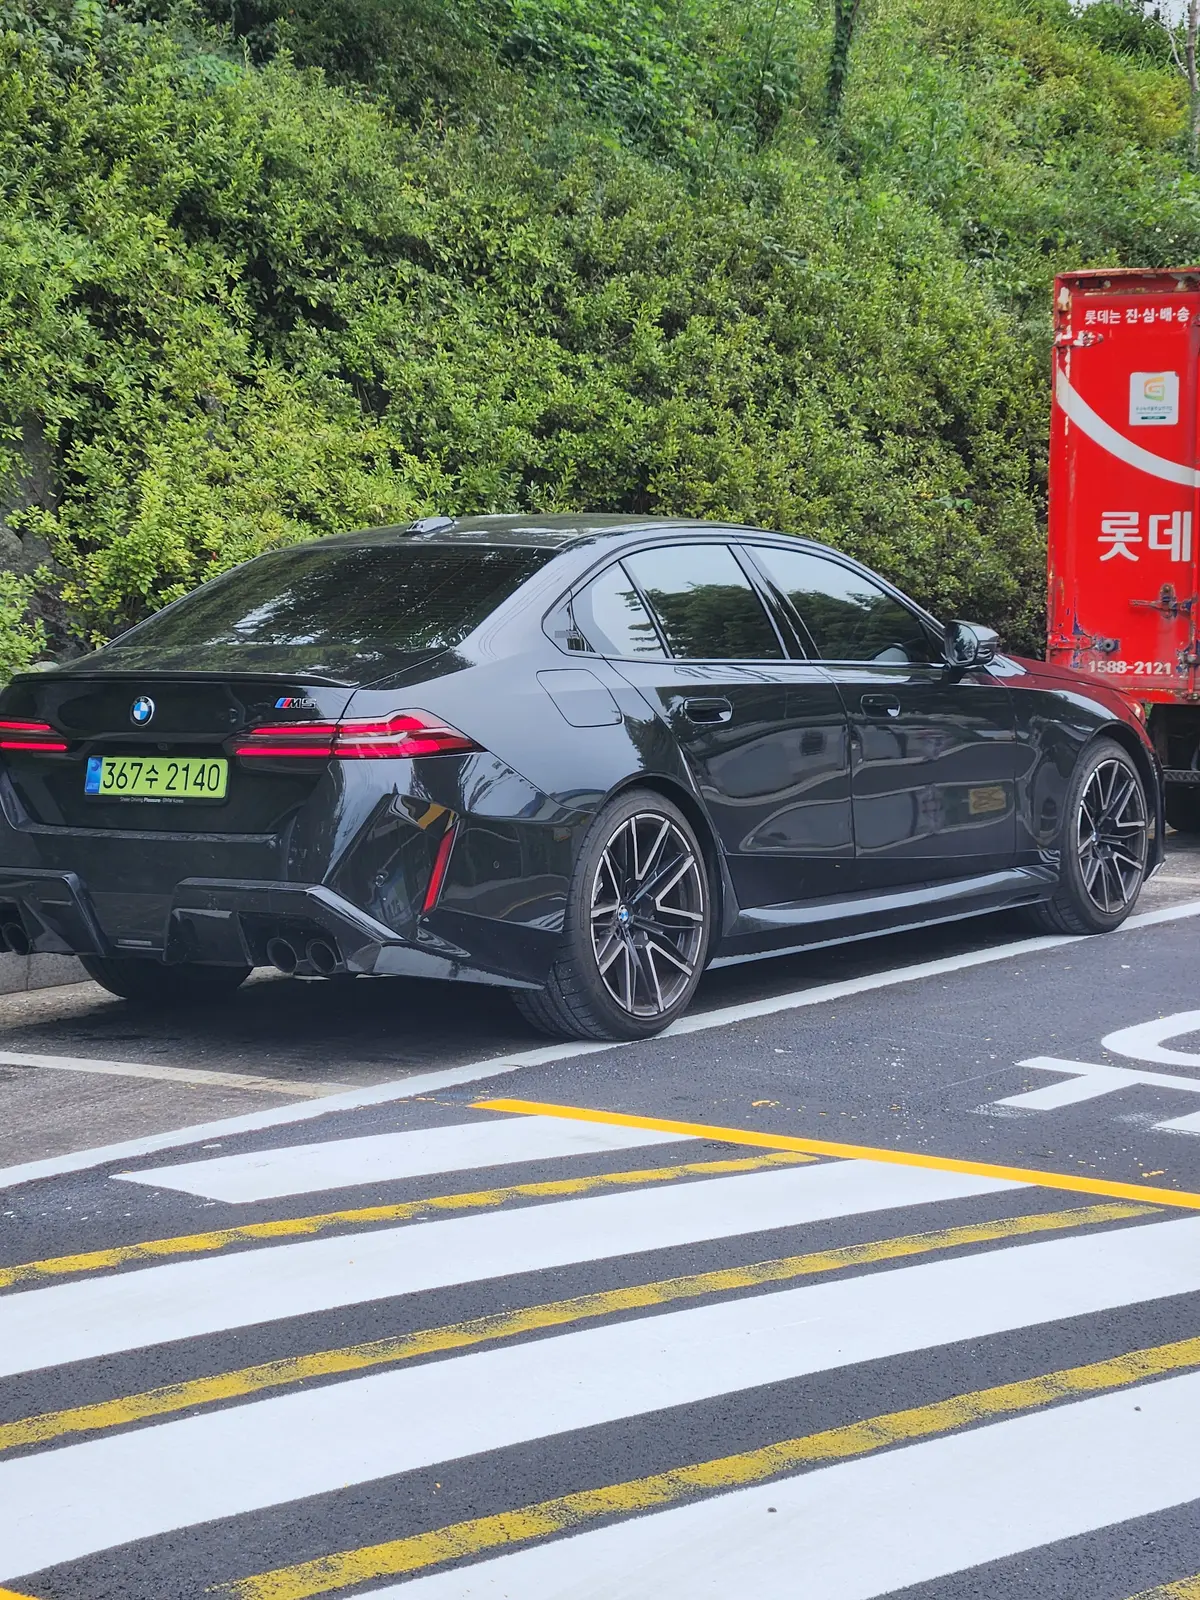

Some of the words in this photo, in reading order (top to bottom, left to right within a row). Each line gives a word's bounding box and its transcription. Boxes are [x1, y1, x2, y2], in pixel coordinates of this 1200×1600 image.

[1085, 309, 1121, 325] 롯데는
[1097, 511, 1192, 562] 롯데
[1088, 660, 1172, 675] 1588-2121
[102, 762, 159, 790] 367수
[165, 763, 221, 791] 2140
